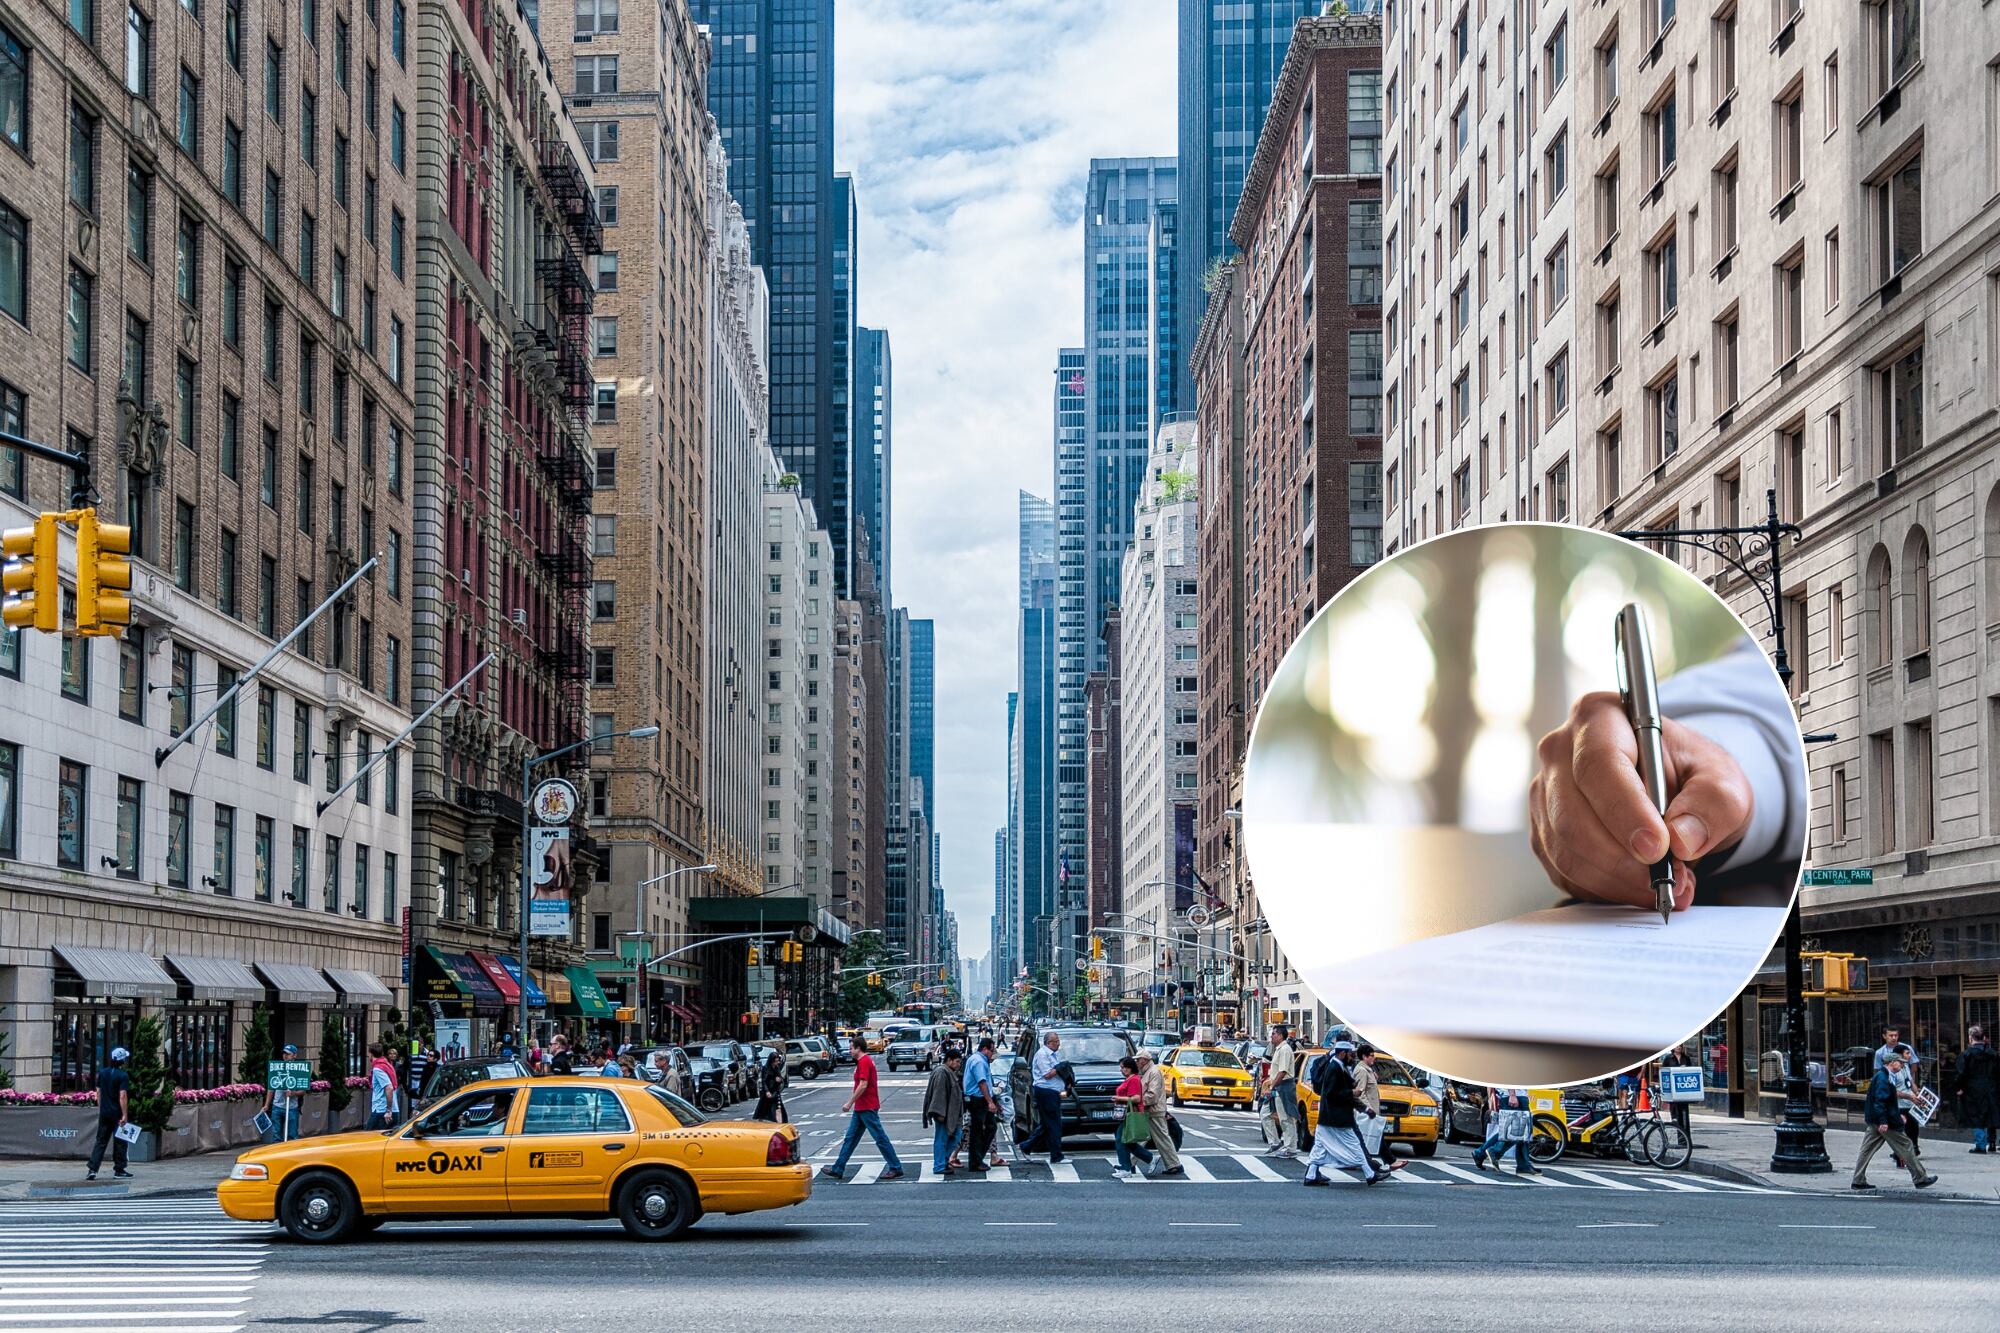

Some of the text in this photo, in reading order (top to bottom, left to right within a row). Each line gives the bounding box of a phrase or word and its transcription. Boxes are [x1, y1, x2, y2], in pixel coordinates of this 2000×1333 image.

[1812, 870, 1872, 880] CENTRAL PARK
[270, 1063, 310, 1072] BIKE RENTAL
[39, 1129, 78, 1138] MARKET
[396, 1153, 482, 1173] NYC TAXI
